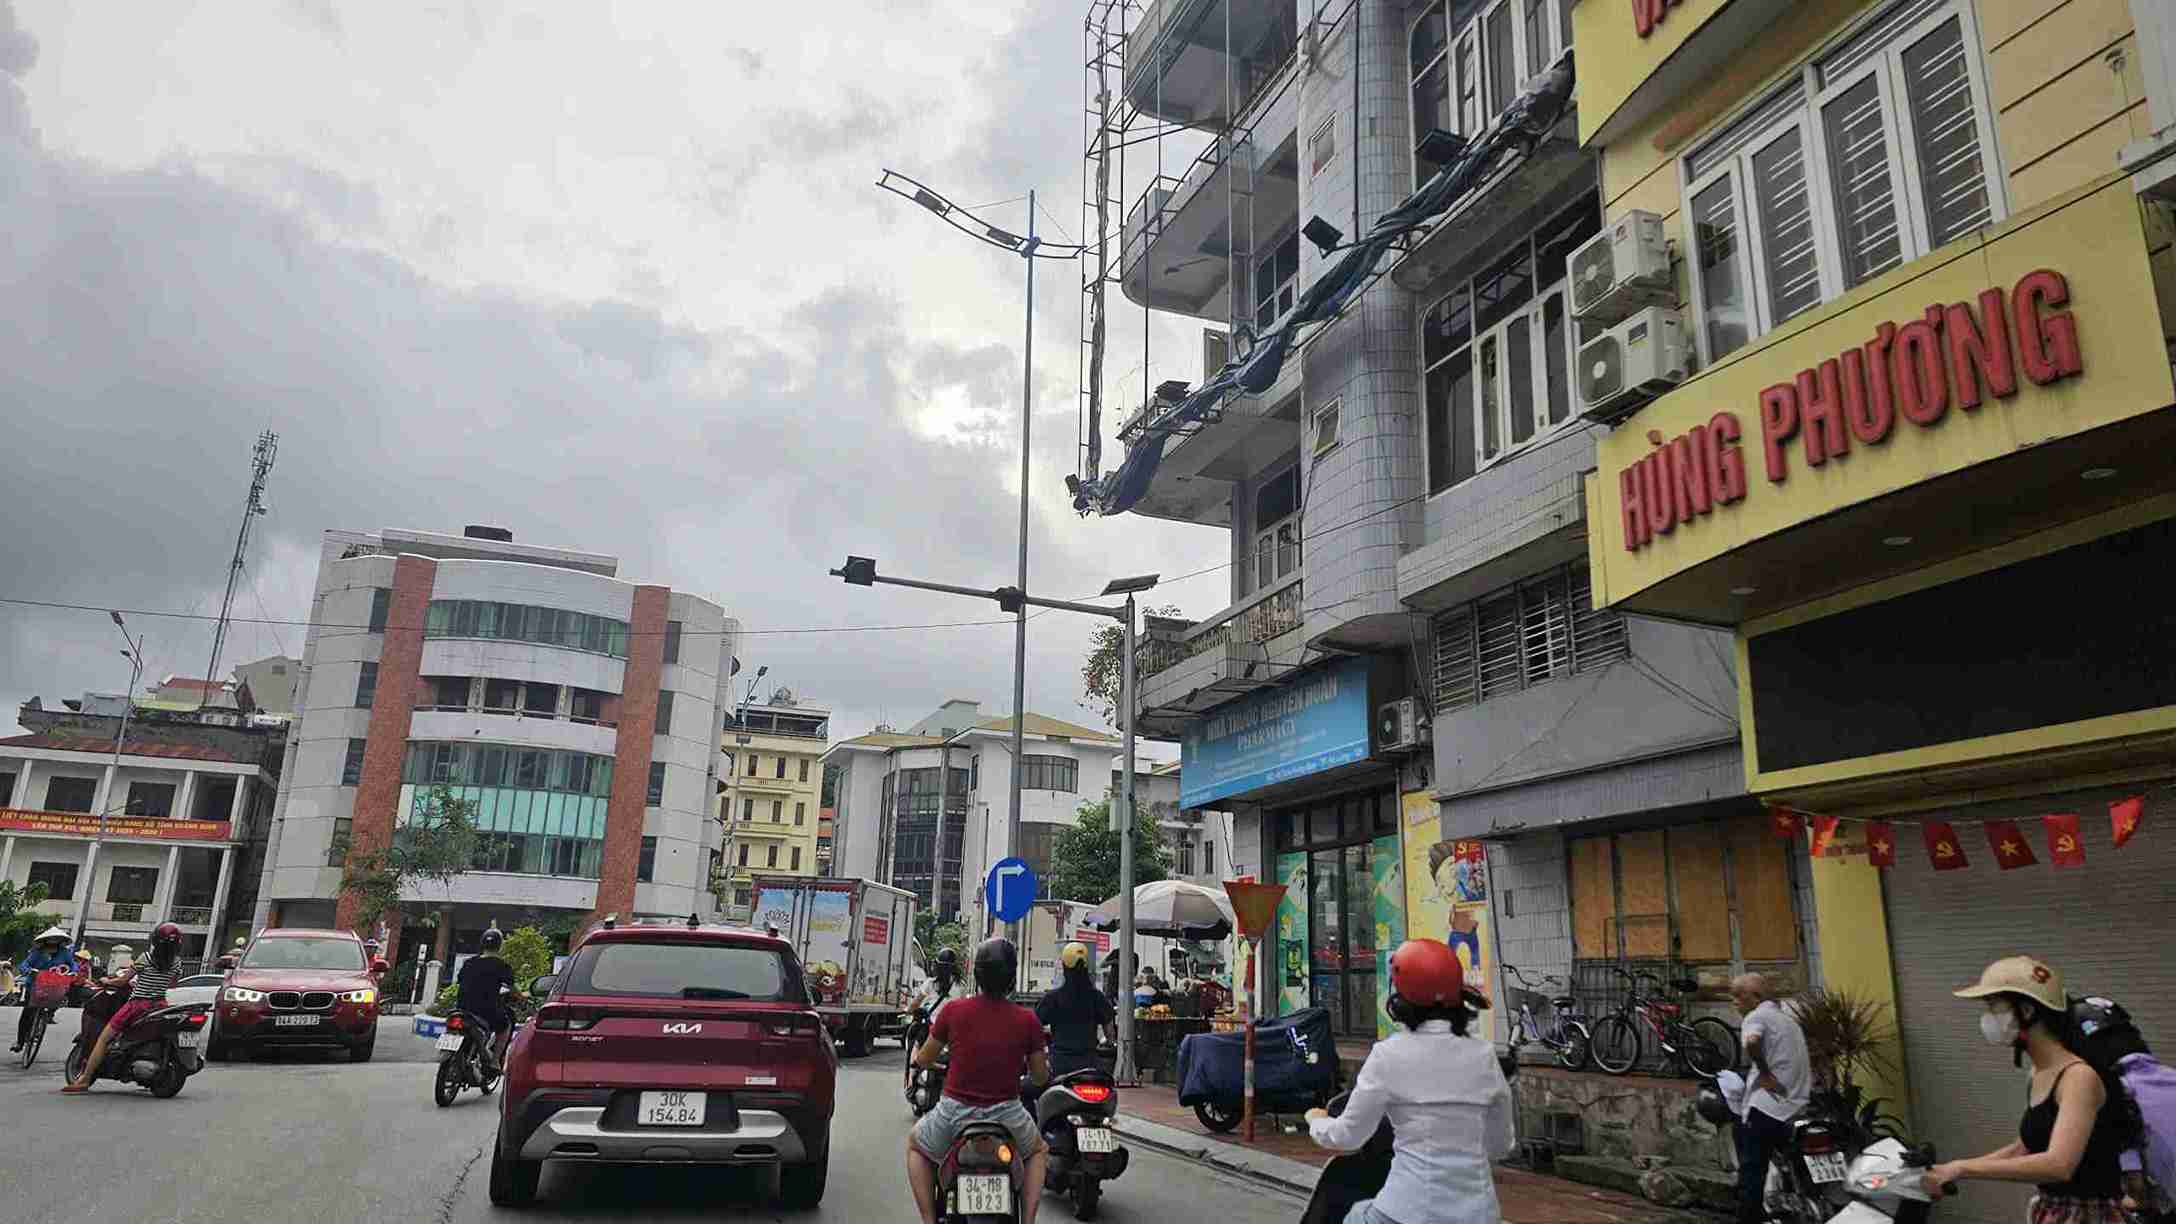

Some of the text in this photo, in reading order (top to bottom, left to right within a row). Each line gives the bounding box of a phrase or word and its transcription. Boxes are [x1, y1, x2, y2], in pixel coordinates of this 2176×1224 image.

[1618, 268, 2083, 551] HÙNG PHƯƠNG
[662, 1023, 702, 1034] KIA
[659, 1092, 688, 1107] 30K
[648, 1108, 697, 1122] 154.84
[967, 1195, 1002, 1210] 1823
